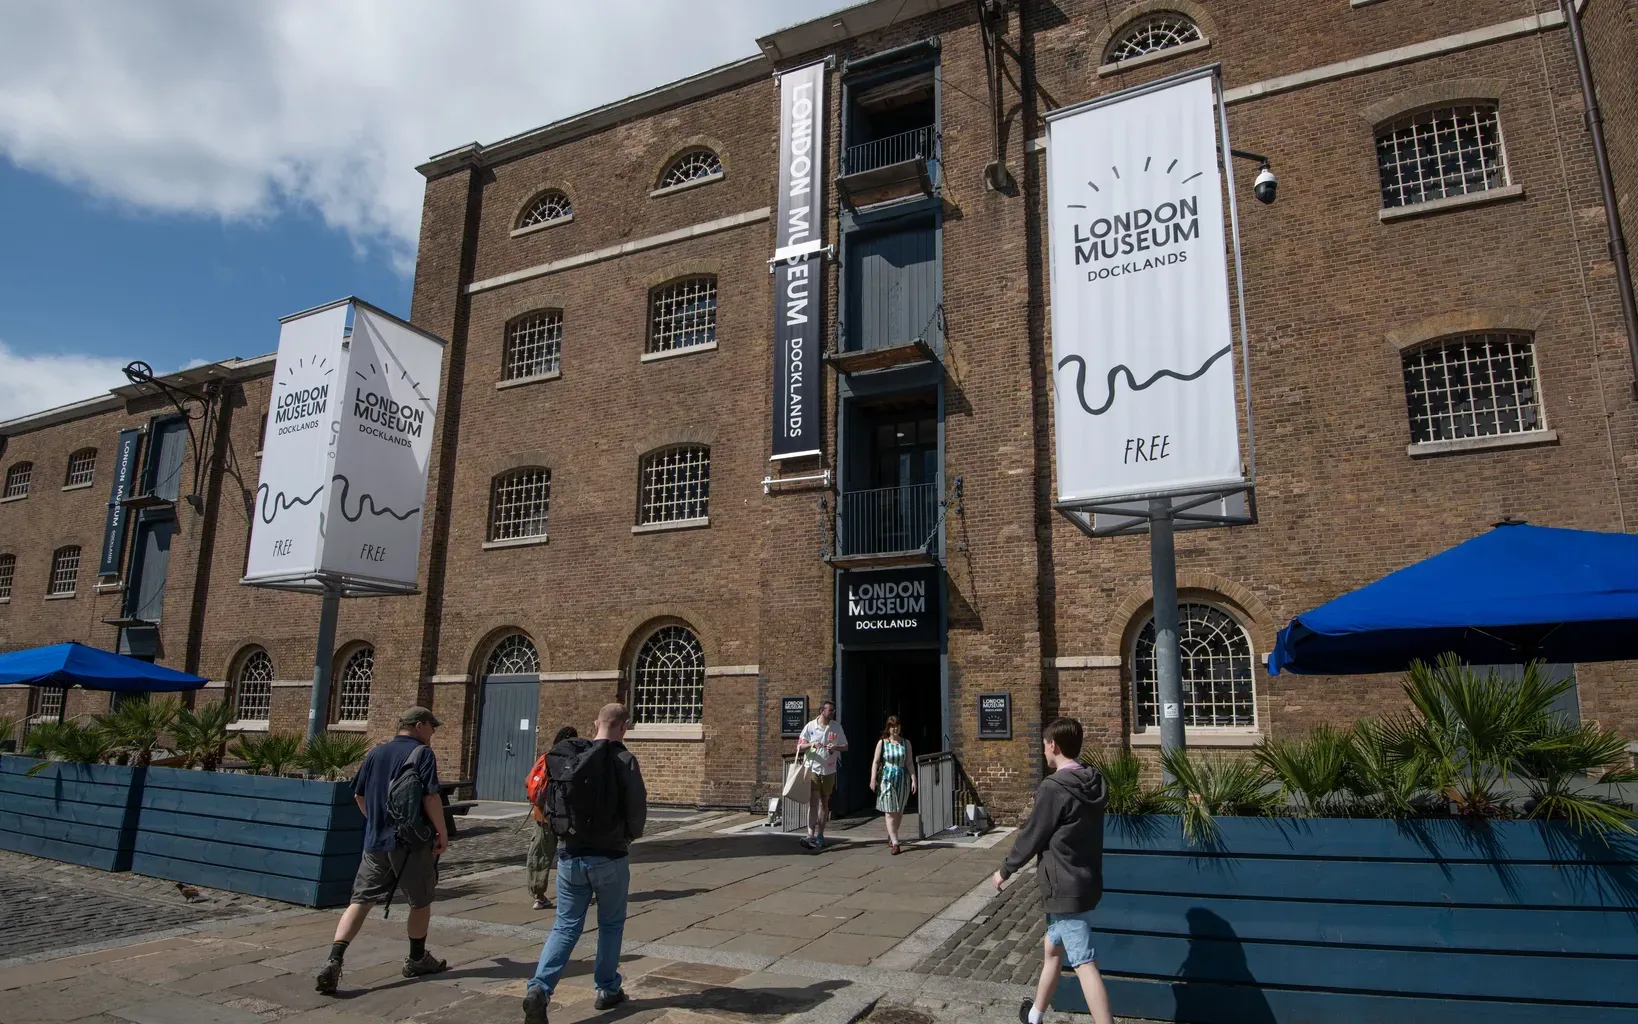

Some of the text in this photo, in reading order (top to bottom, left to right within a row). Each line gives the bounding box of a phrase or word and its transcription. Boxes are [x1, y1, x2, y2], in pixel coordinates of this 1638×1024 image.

[790, 81, 812, 197] LONDON
[1074, 195, 1198, 243] LONDON
[1075, 218, 1199, 265] MUSEUM
[1088, 251, 1187, 282] DOCKLANDS
[277, 384, 329, 409] LONDON
[790, 337, 803, 438] DOCKLANDS
[275, 399, 327, 424] MUSEUM
[355, 387, 424, 424] LONDON
[278, 420, 319, 436] DOCKLANDS
[353, 402, 422, 438] MUSEUM
[359, 423, 412, 449] DOCKLANDS
[1124, 435, 1170, 464] FREE
[120, 440, 130, 482] LONDON
[273, 539, 293, 557] FREE
[360, 543, 386, 562] FREE
[848, 580, 926, 600] LONDON
[848, 596, 926, 616] MUSEUM
[856, 618, 918, 630] DOCKLANDS
